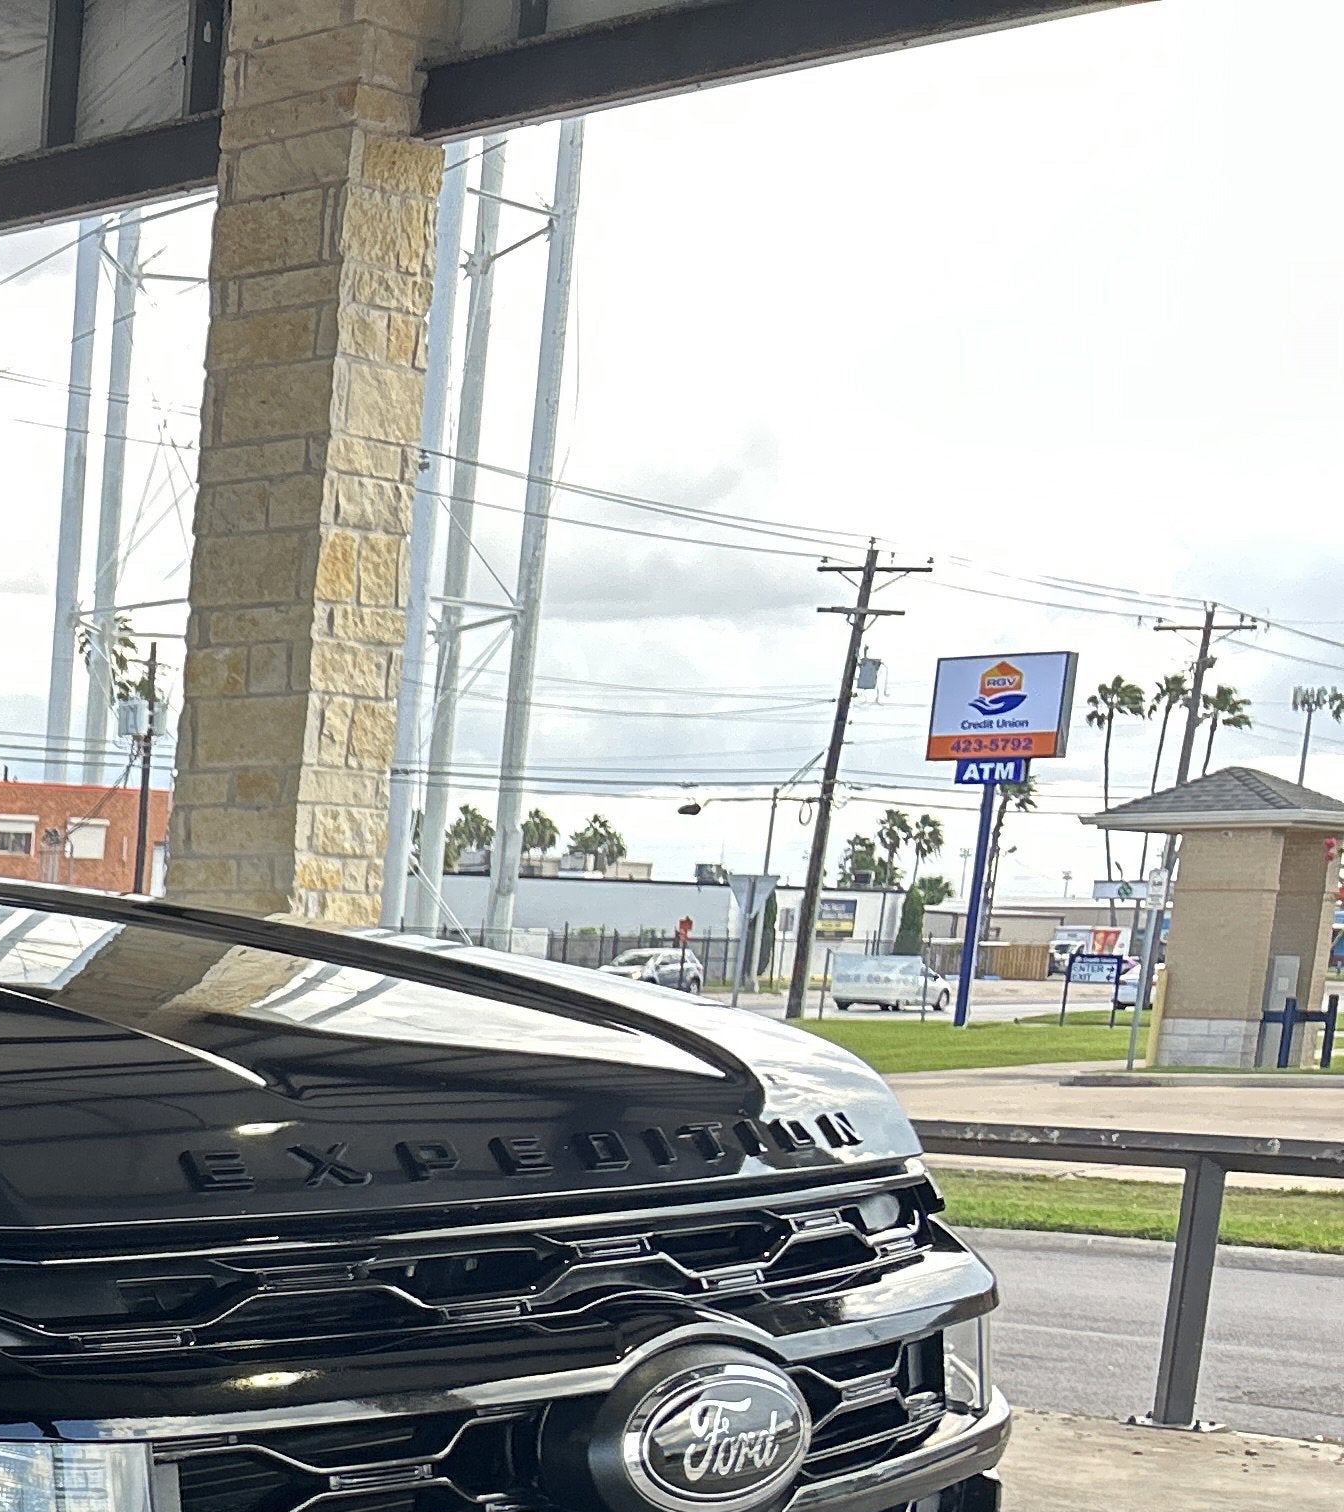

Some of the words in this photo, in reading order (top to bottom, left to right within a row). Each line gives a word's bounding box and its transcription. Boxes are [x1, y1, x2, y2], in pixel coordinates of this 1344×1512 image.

[986, 677, 1017, 688] RGV
[961, 719, 994, 730] Credit
[996, 718, 1029, 729] Union
[950, 737, 1034, 753] 423-5792
[962, 761, 1016, 781] ATM
[179, 1112, 865, 1194] EXPEDITION
[683, 1397, 780, 1482] Ford
